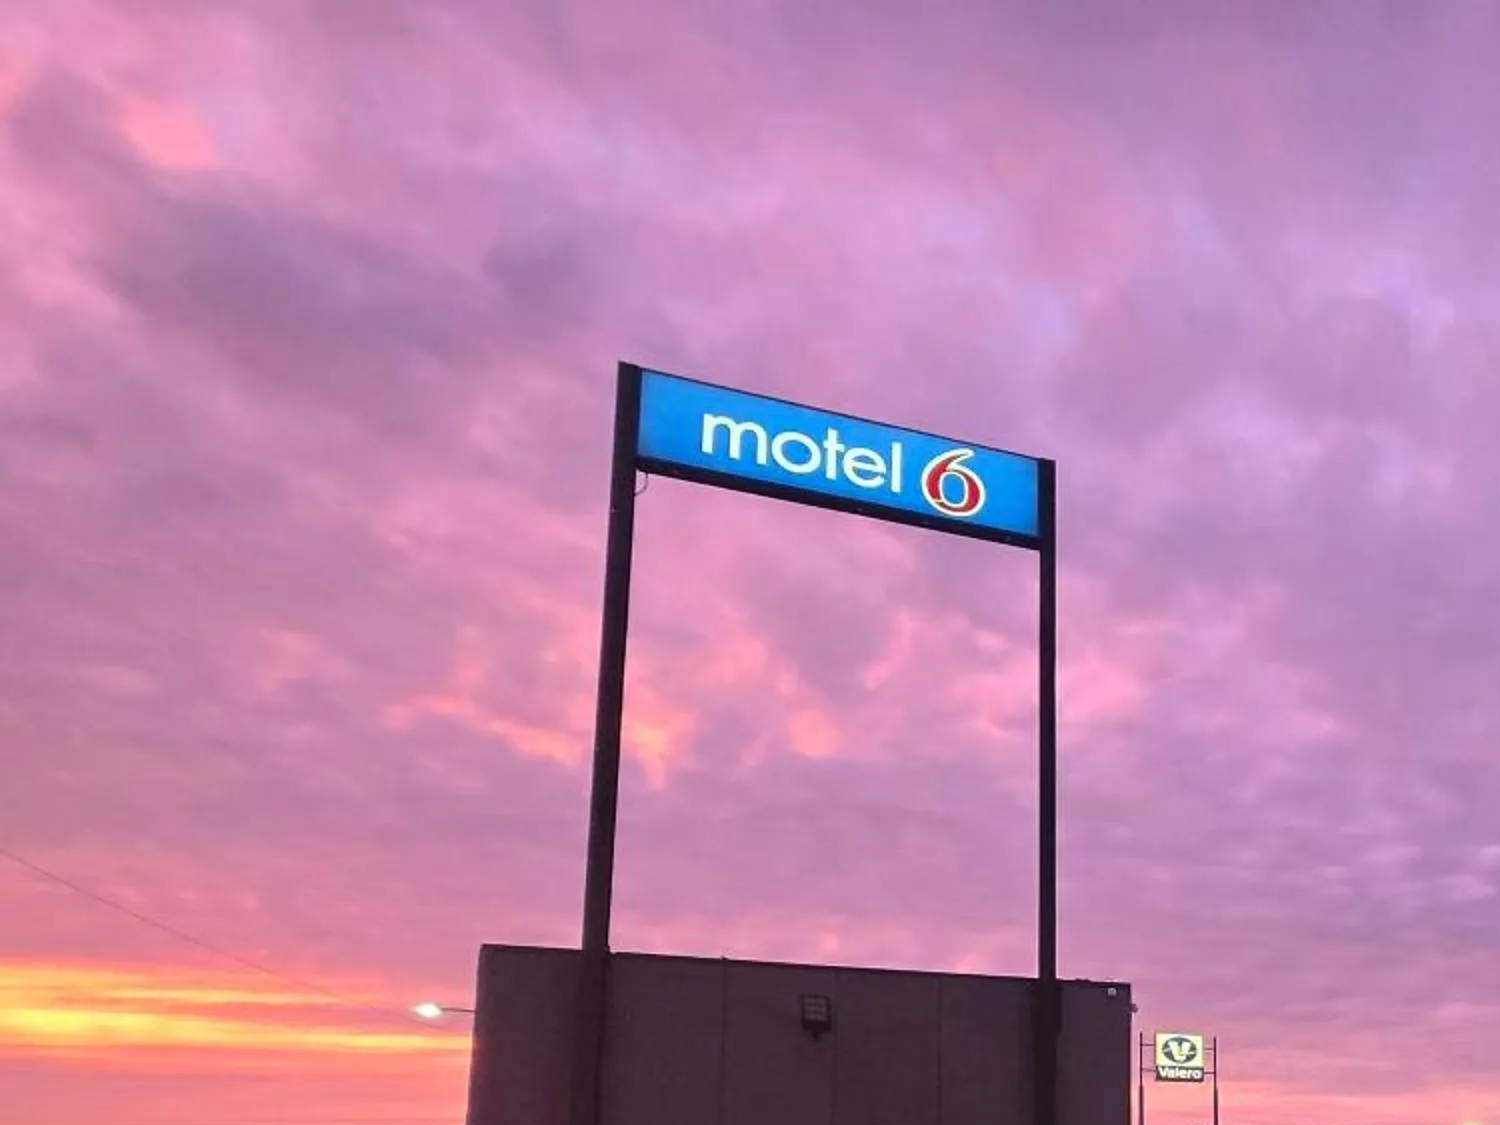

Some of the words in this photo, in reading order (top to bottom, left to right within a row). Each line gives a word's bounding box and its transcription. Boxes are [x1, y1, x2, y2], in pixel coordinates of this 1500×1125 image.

[702, 412, 901, 493] motel
[921, 448, 986, 517] 6
[1158, 1066, 1202, 1079] Valero
